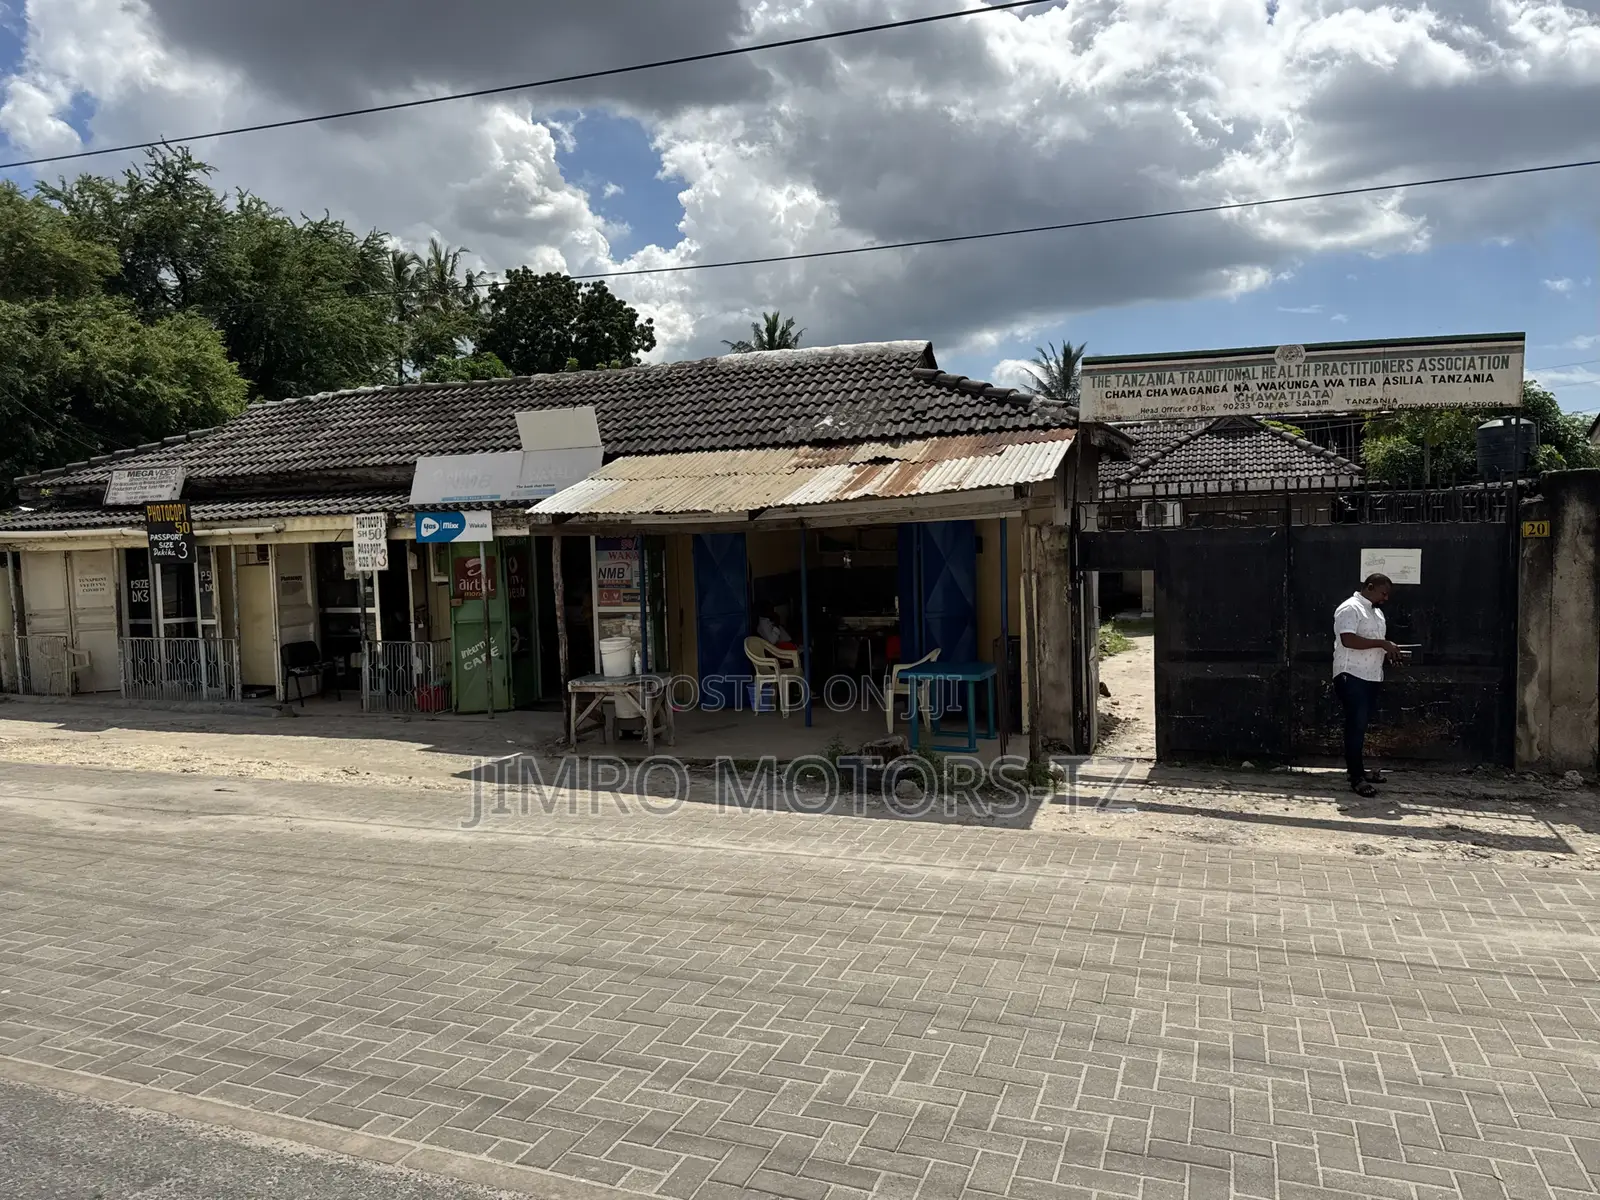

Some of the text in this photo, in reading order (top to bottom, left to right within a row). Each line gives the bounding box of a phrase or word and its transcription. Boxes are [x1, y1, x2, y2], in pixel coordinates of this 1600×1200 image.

[1090, 355, 1510, 389] THE TANZANIA TRADITIONAL HEALTH PRACTITIONERS ASSOCIATION
[1105, 389, 1142, 399] CHAMA
[1234, 383, 1250, 393] NA
[1256, 379, 1319, 391] WAKUNGA
[1324, 378, 1345, 388] WA
[1349, 377, 1376, 388] TIBA
[1383, 374, 1423, 386] ASILIA
[1431, 373, 1494, 384] TANZANIA
[1257, 401, 1274, 409] Dar
[1278, 400, 1289, 408] es
[1296, 399, 1329, 407] Salaam
[1345, 397, 1398, 405] TANZANIA
[146, 503, 187, 522] PHOTOCOPY
[175, 521, 190, 534] 50
[368, 527, 382, 541] 50
[1527, 523, 1545, 535] 20
[150, 533, 183, 541] PASSPORT
[158, 541, 174, 549] SIZE
[178, 541, 188, 559] 3
[357, 543, 381, 555] PASSPORT
[358, 556, 369, 568] SIZE
[377, 548, 387, 567] 3
[608, 551, 640, 560] WAKA
[598, 567, 625, 579] NMB
[459, 578, 494, 591] airtl
